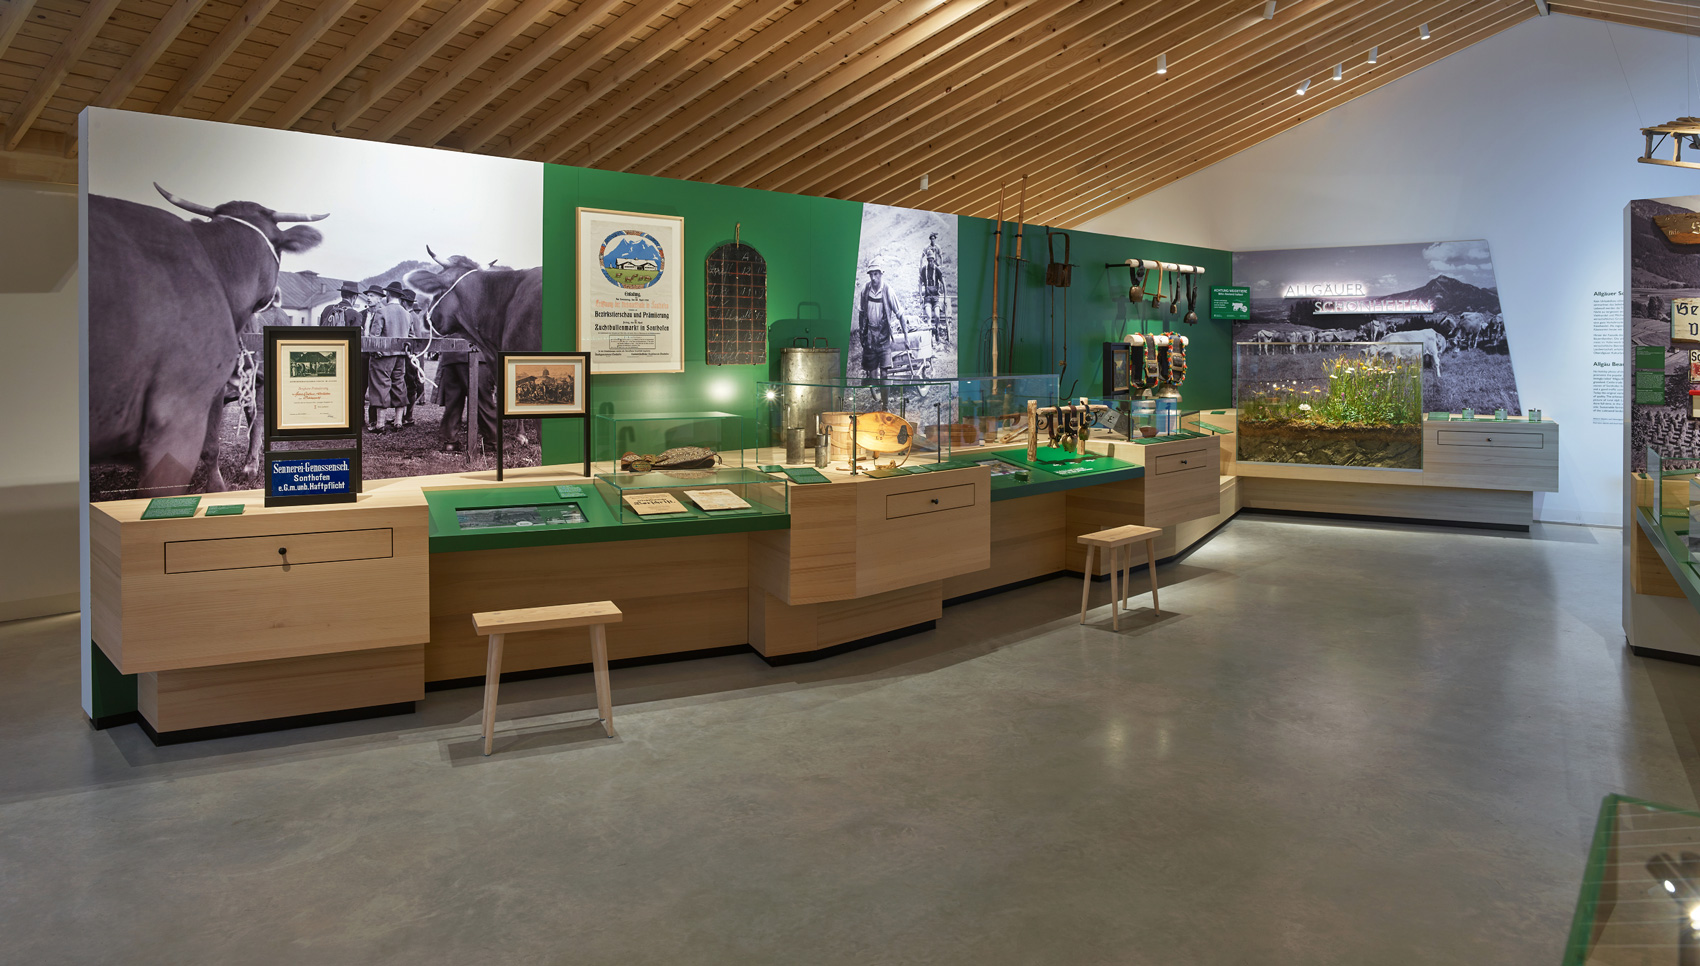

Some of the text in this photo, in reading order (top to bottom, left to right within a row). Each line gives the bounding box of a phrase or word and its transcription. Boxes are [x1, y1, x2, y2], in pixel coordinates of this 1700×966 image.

[1286, 283, 1365, 296] ALLGÄUER
[273, 460, 350, 474] Sennerei-Genossensch.
[293, 473, 331, 482] Sonthofen
